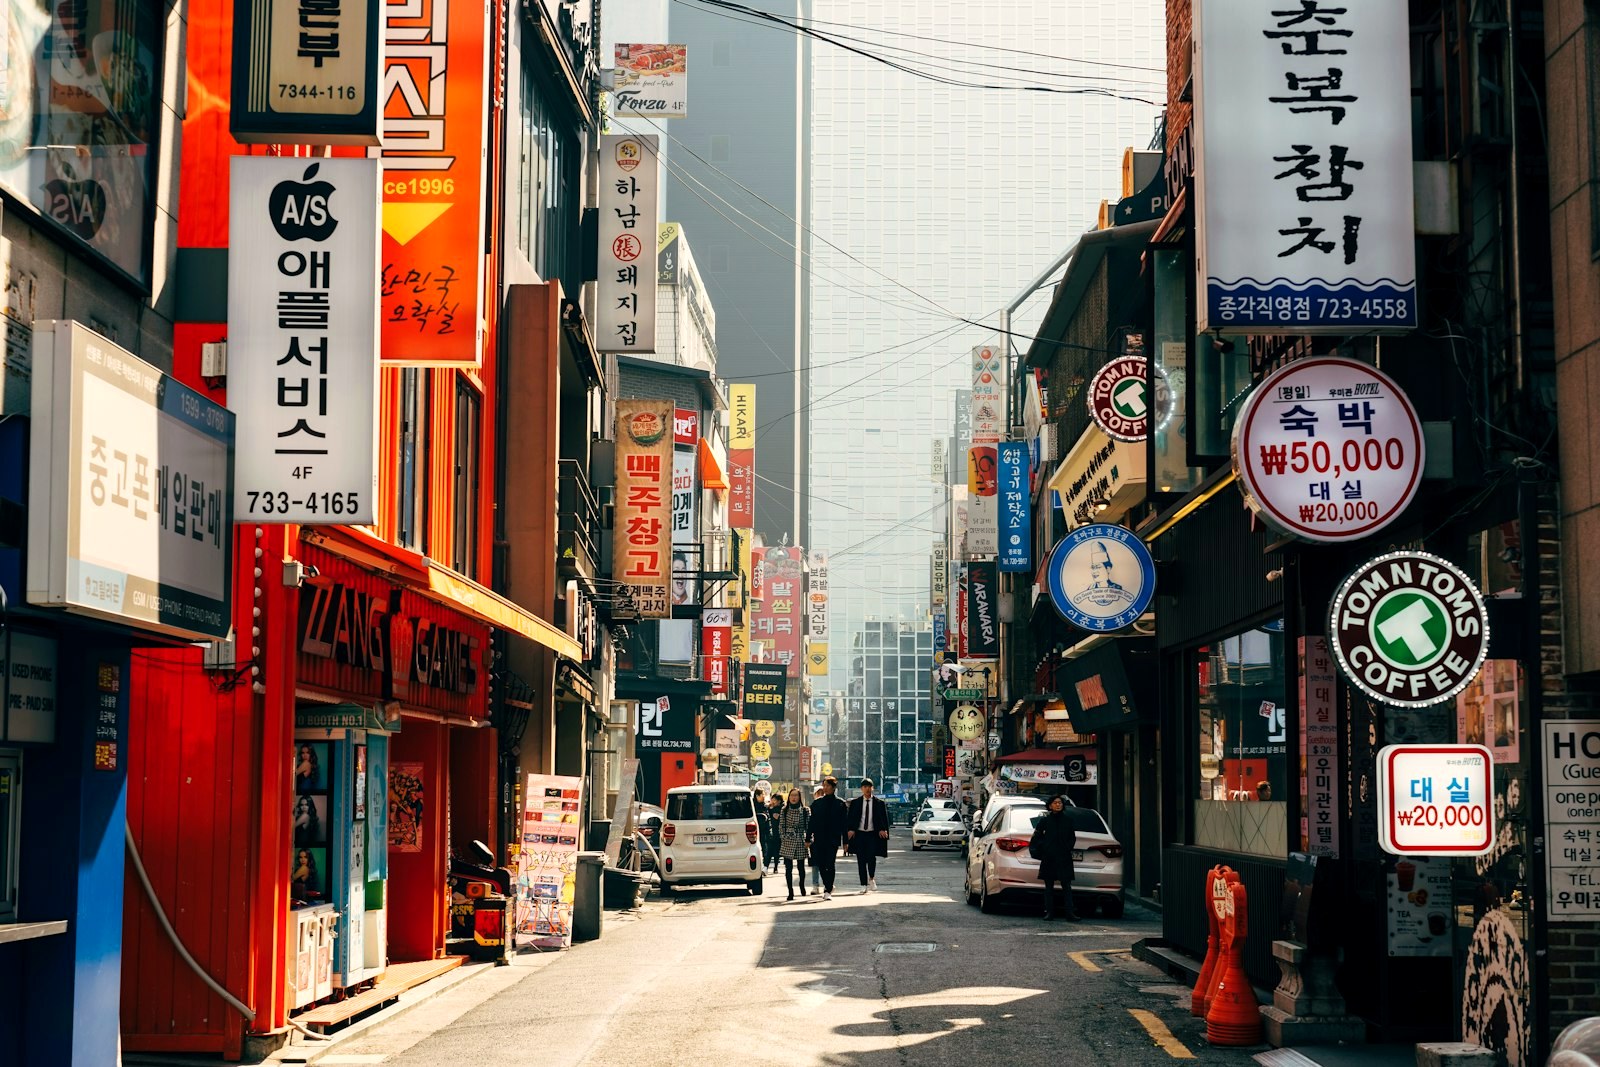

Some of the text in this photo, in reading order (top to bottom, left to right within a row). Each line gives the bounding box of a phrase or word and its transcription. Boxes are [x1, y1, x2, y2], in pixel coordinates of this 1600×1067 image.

[278, 84, 356, 100] 7344-116
[617, 90, 685, 110] Forza 4F
[281, 195, 327, 227] A/S
[1218, 296, 1408, 321] 종각직영점 723-4558
[275, 251, 330, 455] 애플서비스
[1096, 367, 1120, 401] TOM
[1329, 387, 1353, 398] 우미관
[1353, 382, 1381, 396] HOTEL
[736, 395, 747, 439] HIKARI
[1260, 437, 1404, 479] ₩50,000
[292, 466, 313, 479] 4F
[674, 477, 691, 490] 있다
[247, 491, 359, 515] 733-4165
[1299, 501, 1378, 524] ₩20,000
[624, 454, 662, 577] 맥주창고
[617, 585, 666, 598] 계맥주
[1342, 562, 1480, 638] TOM N TOMS
[971, 567, 996, 646] WARAWARA
[416, 617, 480, 695] GAMES
[12, 663, 53, 682] USED PHONE
[1350, 645, 1470, 698] COFFEE
[746, 693, 783, 705] BEER
[307, 715, 339, 726] BOOTH
[341, 715, 363, 726] NO.1
[1315, 758, 1333, 844] 우미관호텔
[1556, 792, 1586, 804] one
[1397, 805, 1484, 830] ₩20,000
[1563, 829, 1591, 843] 숙박
[1563, 848, 1591, 862] 대실
[1569, 874, 1600, 886] TEL.
[1397, 910, 1411, 918] TEA
